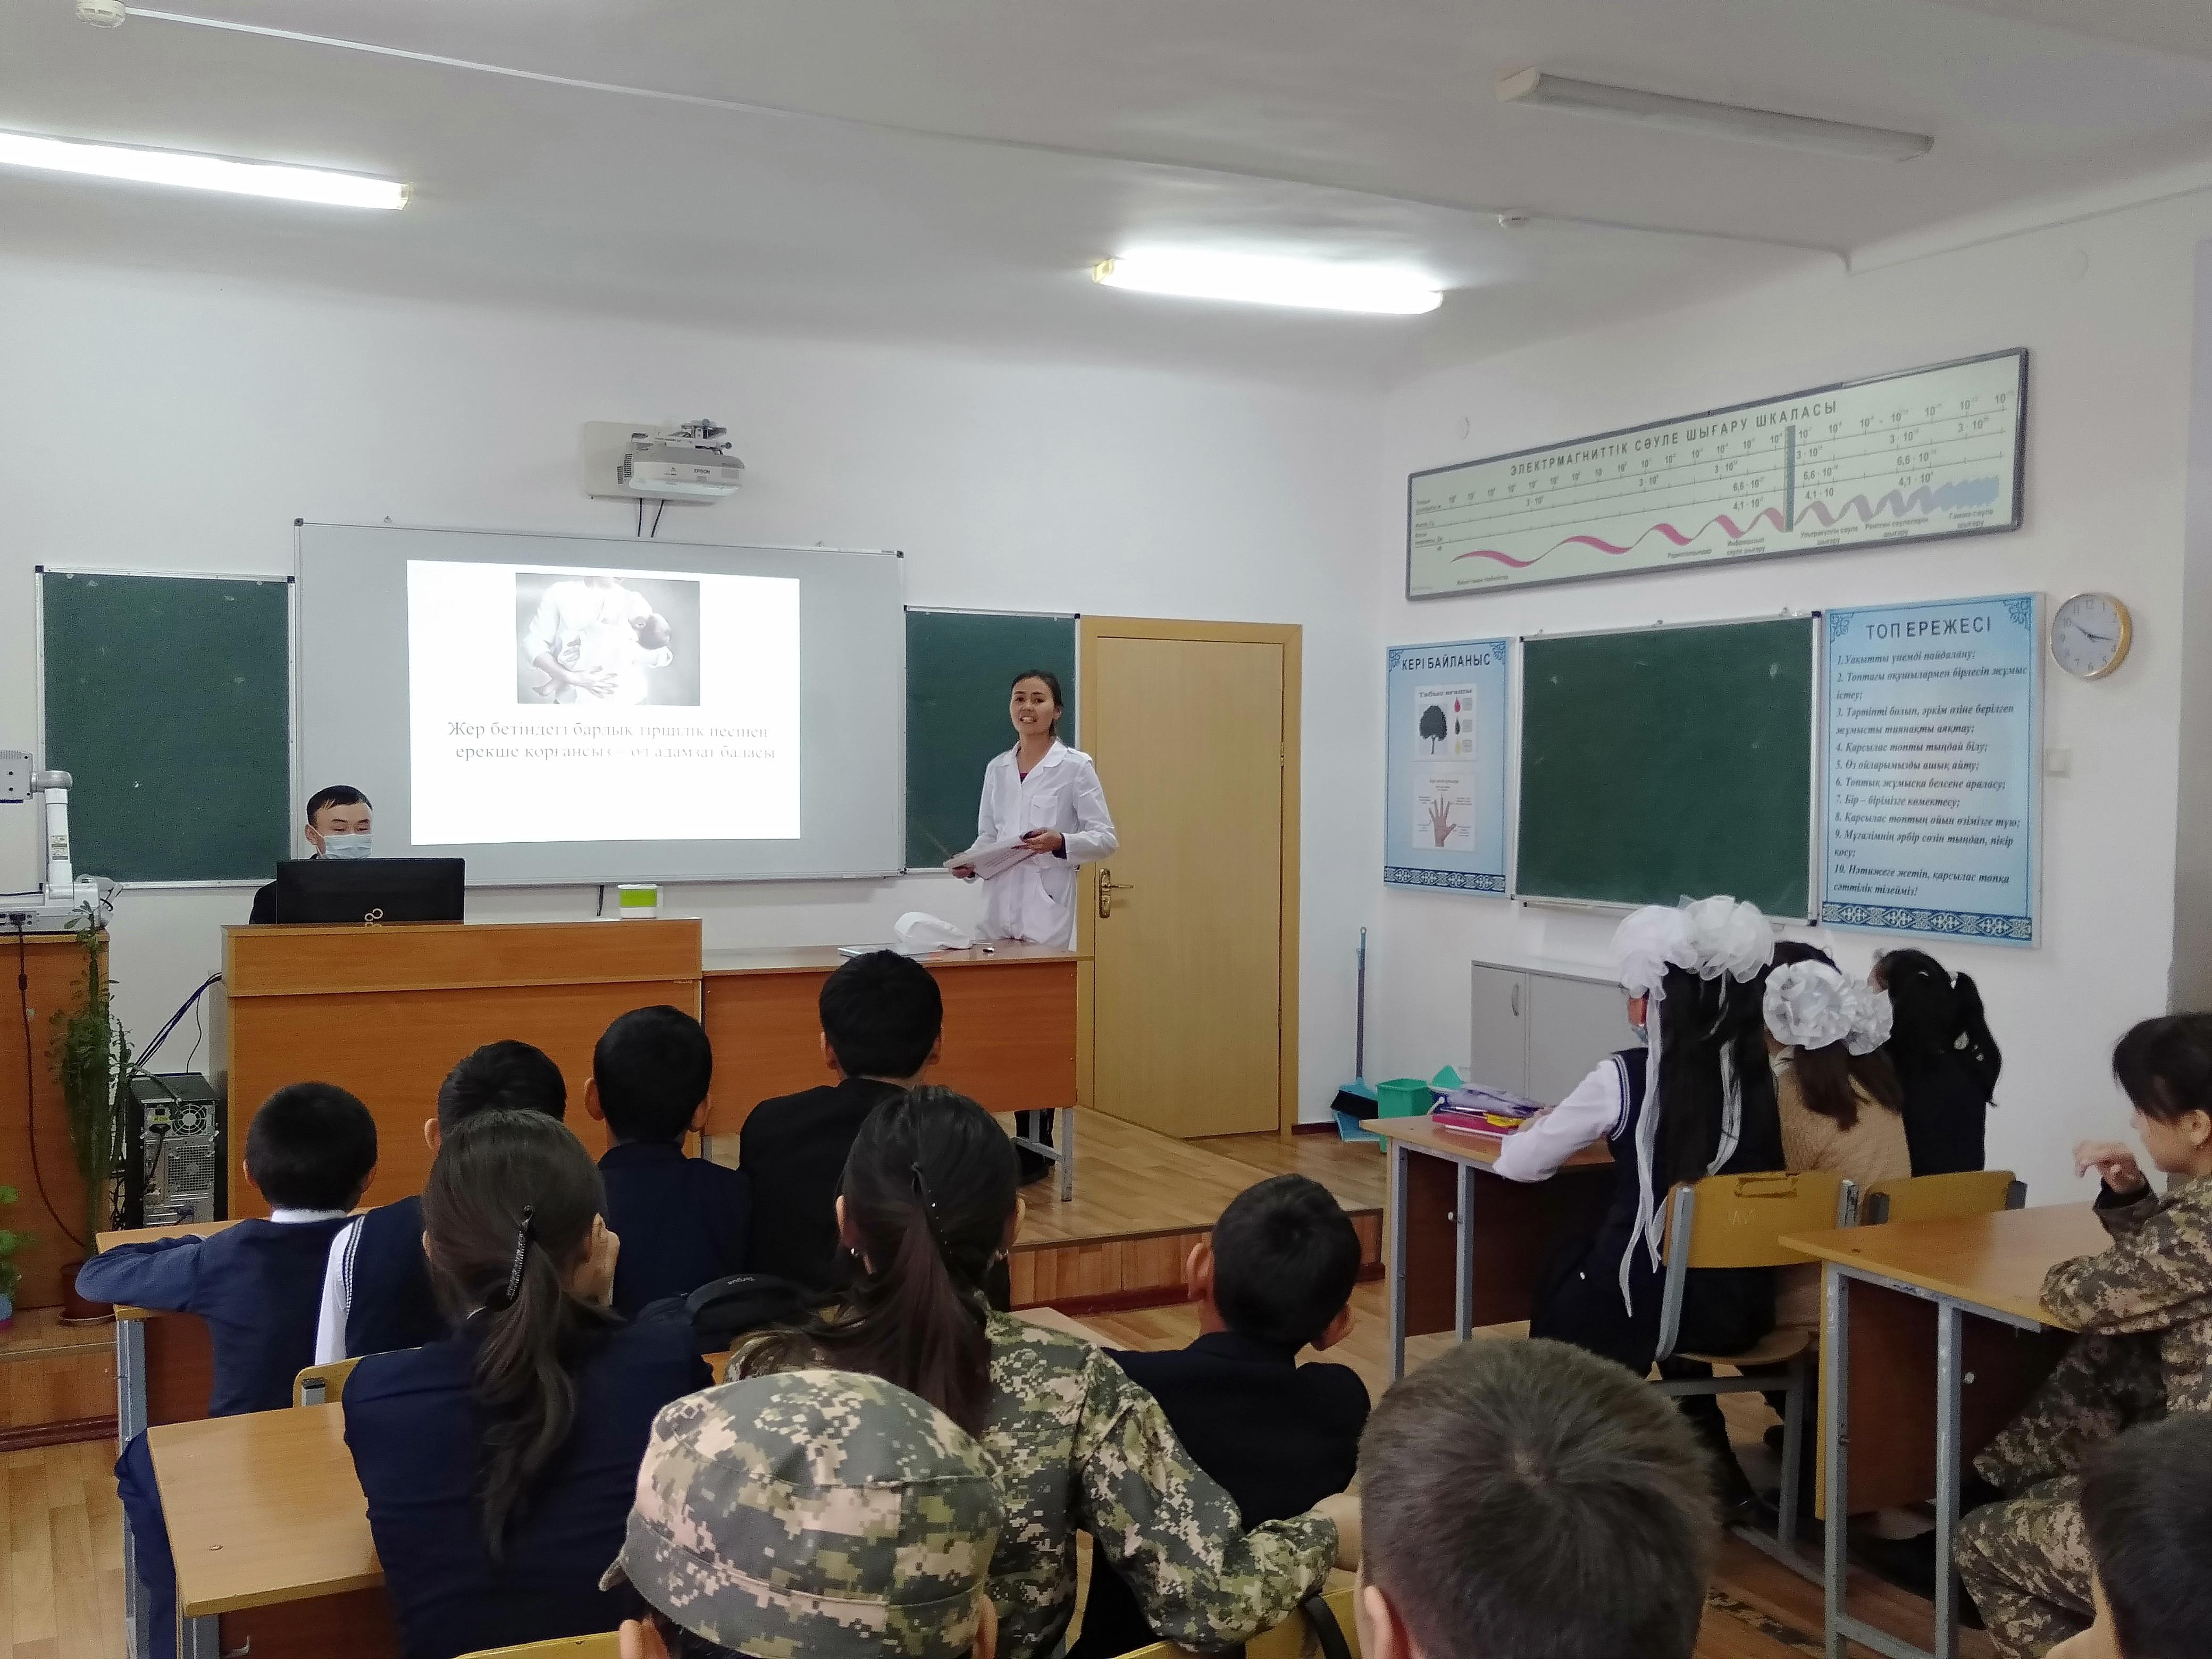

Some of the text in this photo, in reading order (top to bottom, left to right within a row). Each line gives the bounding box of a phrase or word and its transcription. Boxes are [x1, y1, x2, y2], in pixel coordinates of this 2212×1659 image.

[1510, 443, 1628, 476] ЭЛЕКТРМАГНИТТІК
[1687, 418, 1747, 441] ШЫҒАРУ
[1756, 401, 1836, 428] ШКАЛАСЫ
[1866, 616, 1990, 640] ТОП ЕРЕЖЕСІ
[1402, 653, 1490, 671] КЕРІ БАЙЛАНЫС
[448, 722, 485, 739] Жер
[456, 748, 518, 761] ерекше
[1929, 777, 1963, 788] белсене
[1845, 795, 1859, 807] Бір
[1990, 835, 2014, 848] пікір
